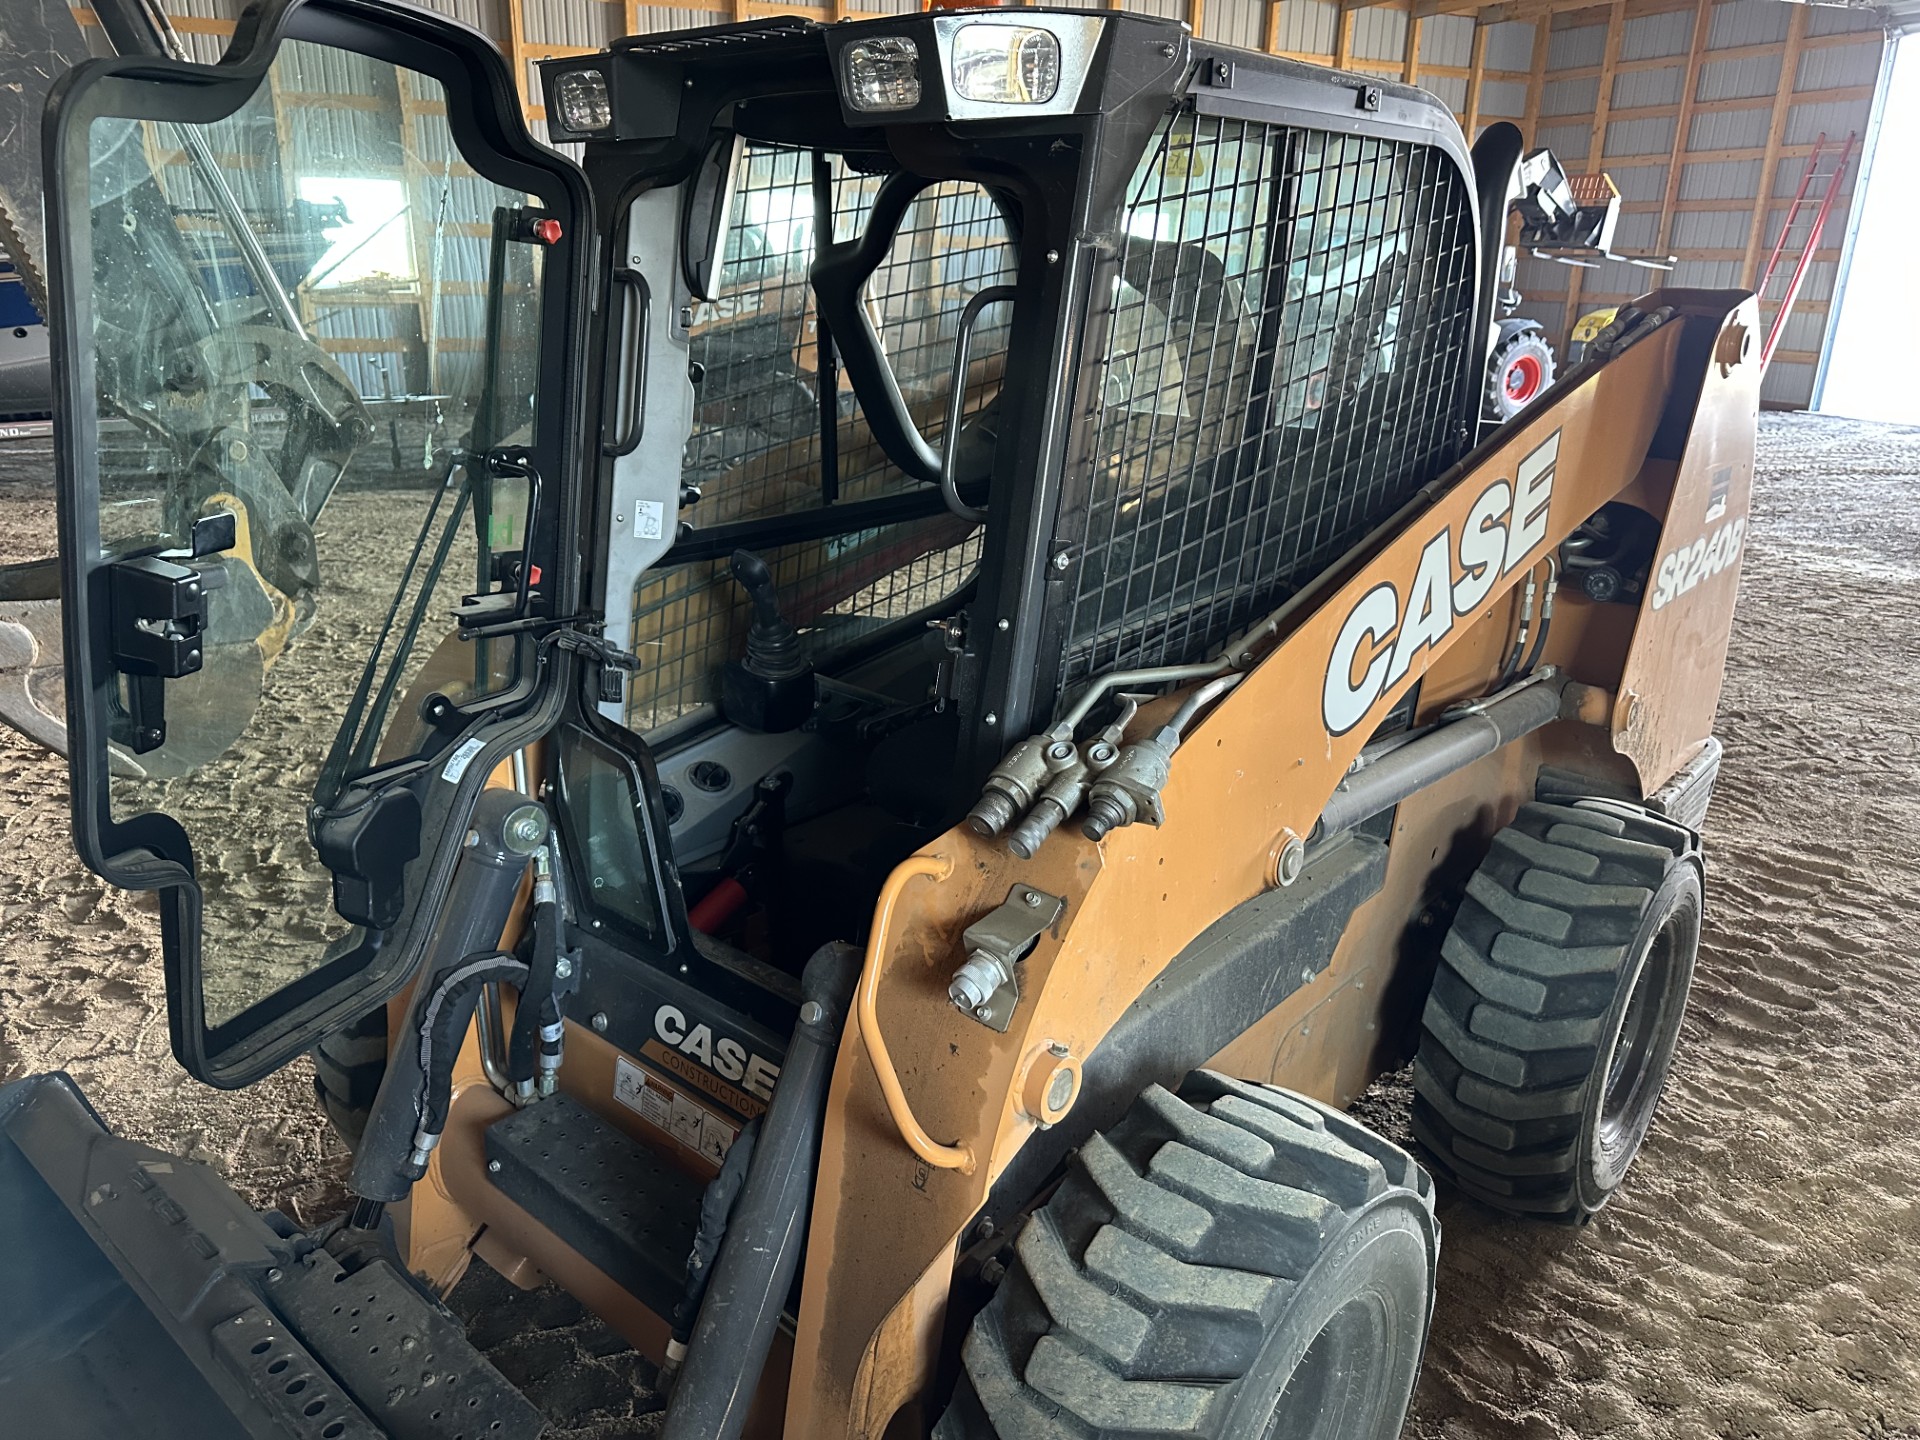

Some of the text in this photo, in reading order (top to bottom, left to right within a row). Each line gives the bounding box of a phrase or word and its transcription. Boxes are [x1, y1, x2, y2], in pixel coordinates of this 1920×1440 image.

[1322, 427, 1562, 737] CASE
[1652, 517, 1746, 611] SR240B
[654, 1004, 780, 1102] CASE
[661, 1050, 762, 1116] CONSTRUCTION
